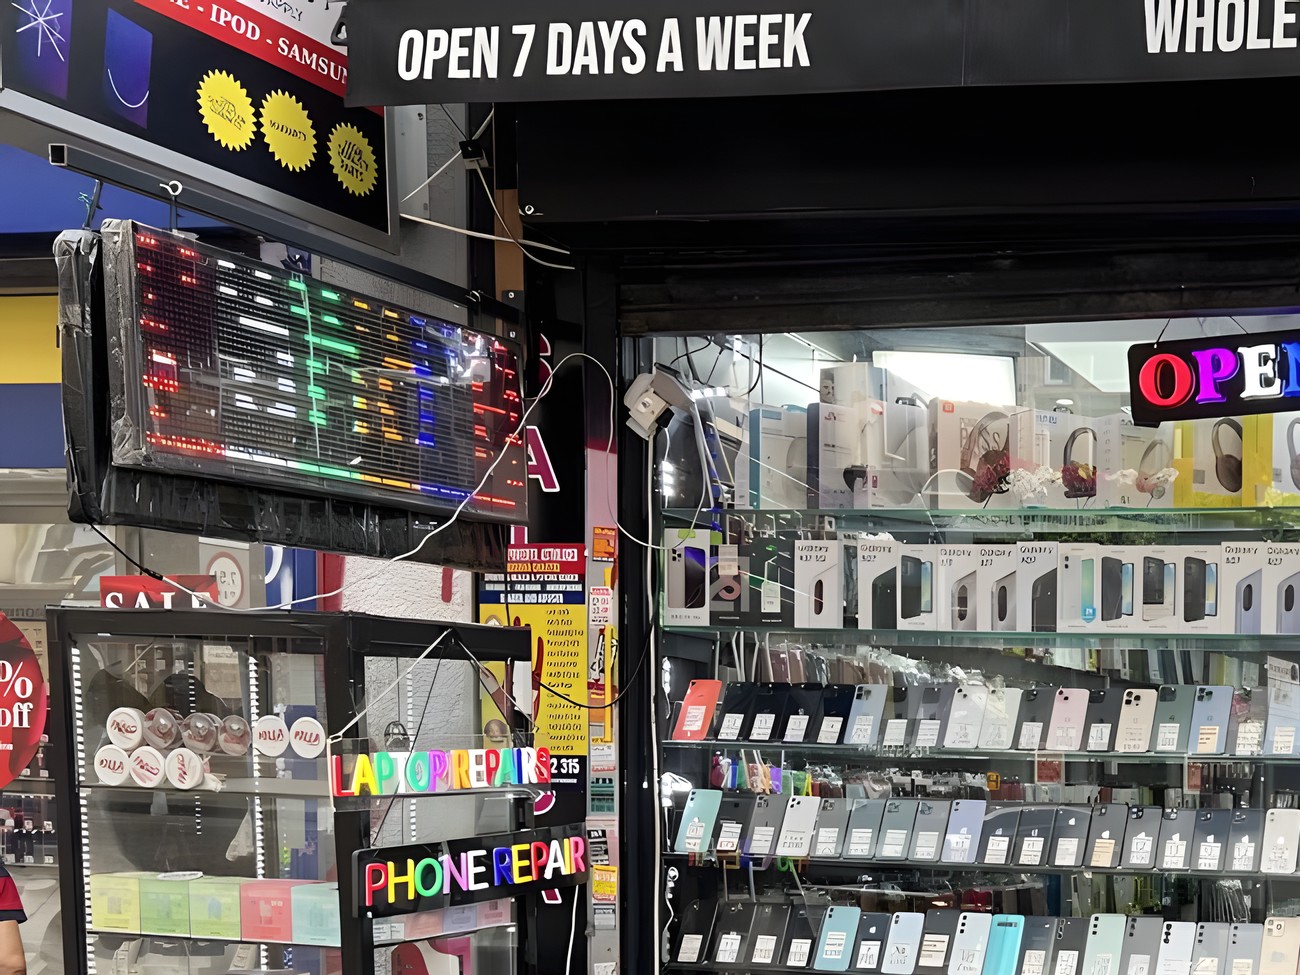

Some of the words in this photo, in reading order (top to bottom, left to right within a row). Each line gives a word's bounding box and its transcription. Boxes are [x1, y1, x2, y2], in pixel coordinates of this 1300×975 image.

[210, 4, 260, 41] IPOD
[397, 26, 499, 81] OPEN
[512, 24, 536, 77] 7
[546, 18, 647, 75] DAYS
[656, 18, 684, 73] A
[696, 13, 813, 71] WEEK
[332, 750, 449, 797] LAPTOP
[452, 746, 551, 789] REPAIRS
[365, 849, 490, 907] PHONE
[493, 836, 586, 887] REPAIR
